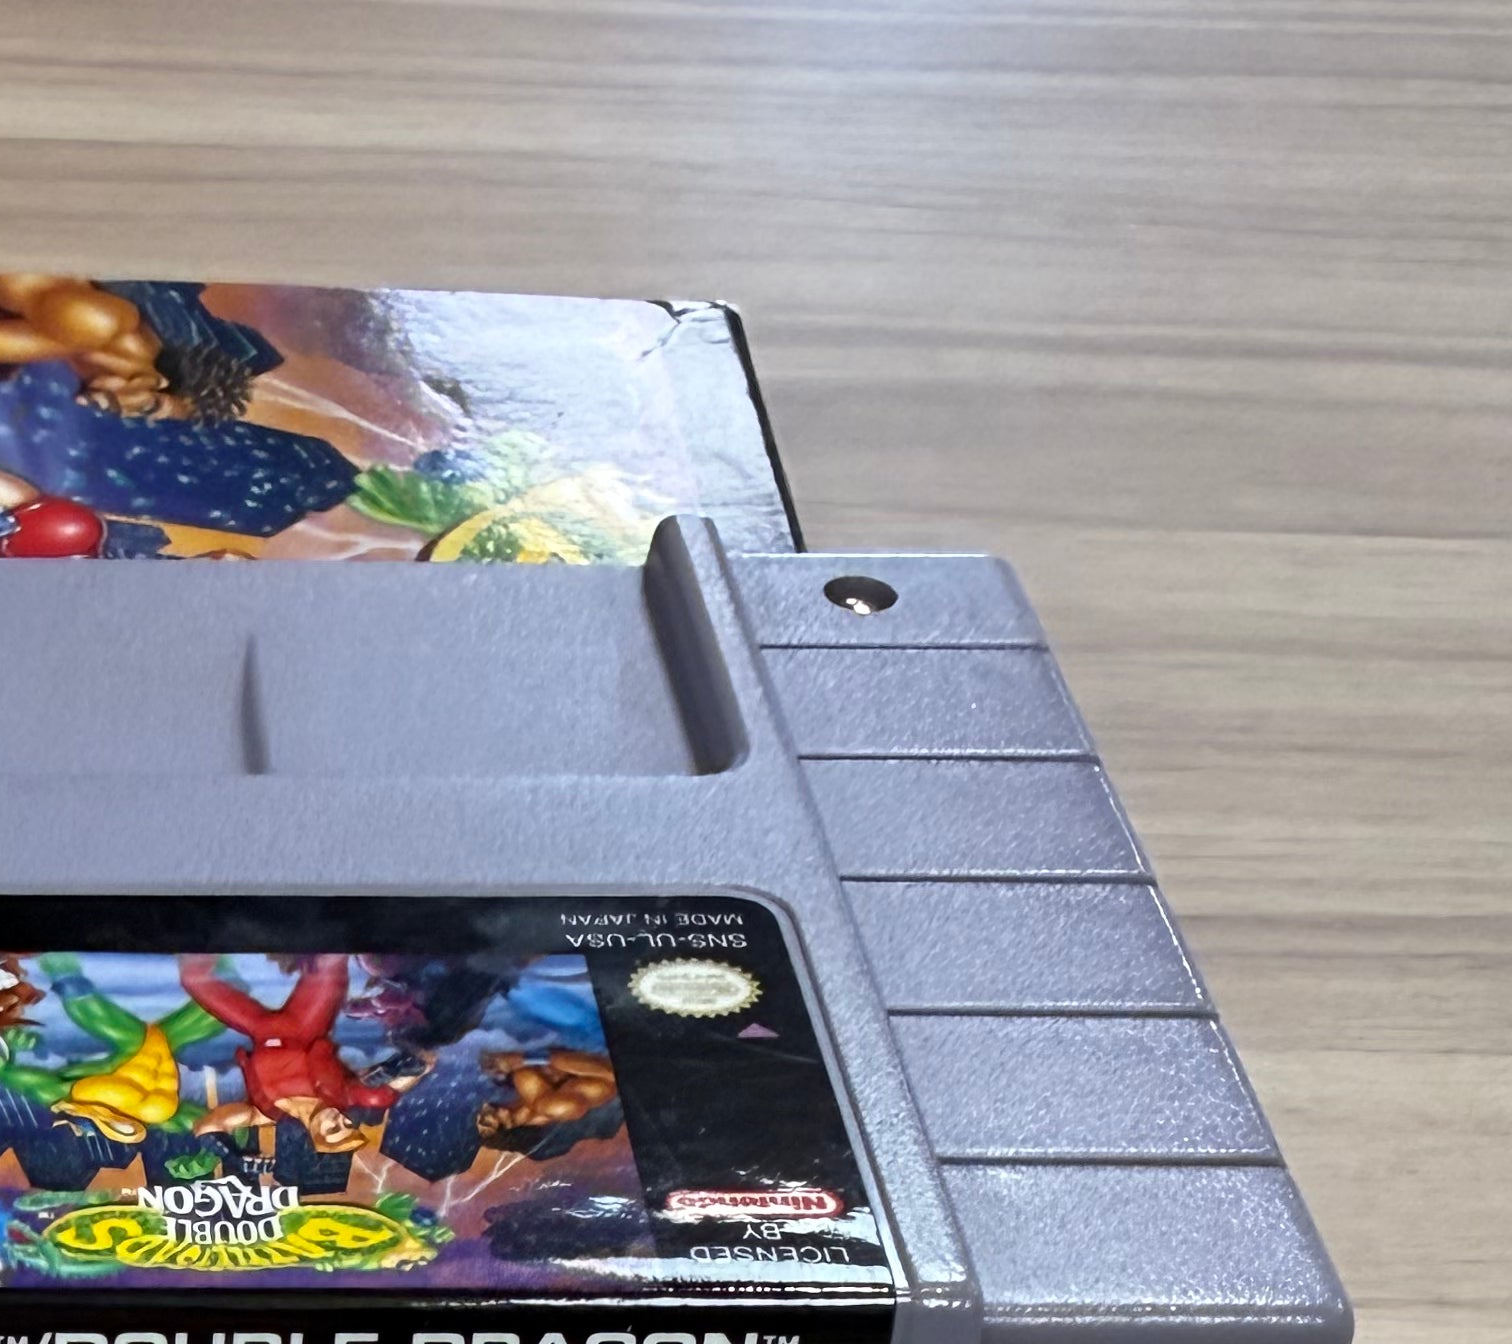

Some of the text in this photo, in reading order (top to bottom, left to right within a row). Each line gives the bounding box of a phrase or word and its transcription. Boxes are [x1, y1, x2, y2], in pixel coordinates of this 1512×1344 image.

[560, 913, 744, 926] MADE IN JAPAN
[565, 932, 748, 949] SNS-UL-USA
[164, 1215, 285, 1246] DOUBLE
[742, 1222, 783, 1241] BY
[690, 1245, 850, 1264] LICENSED
